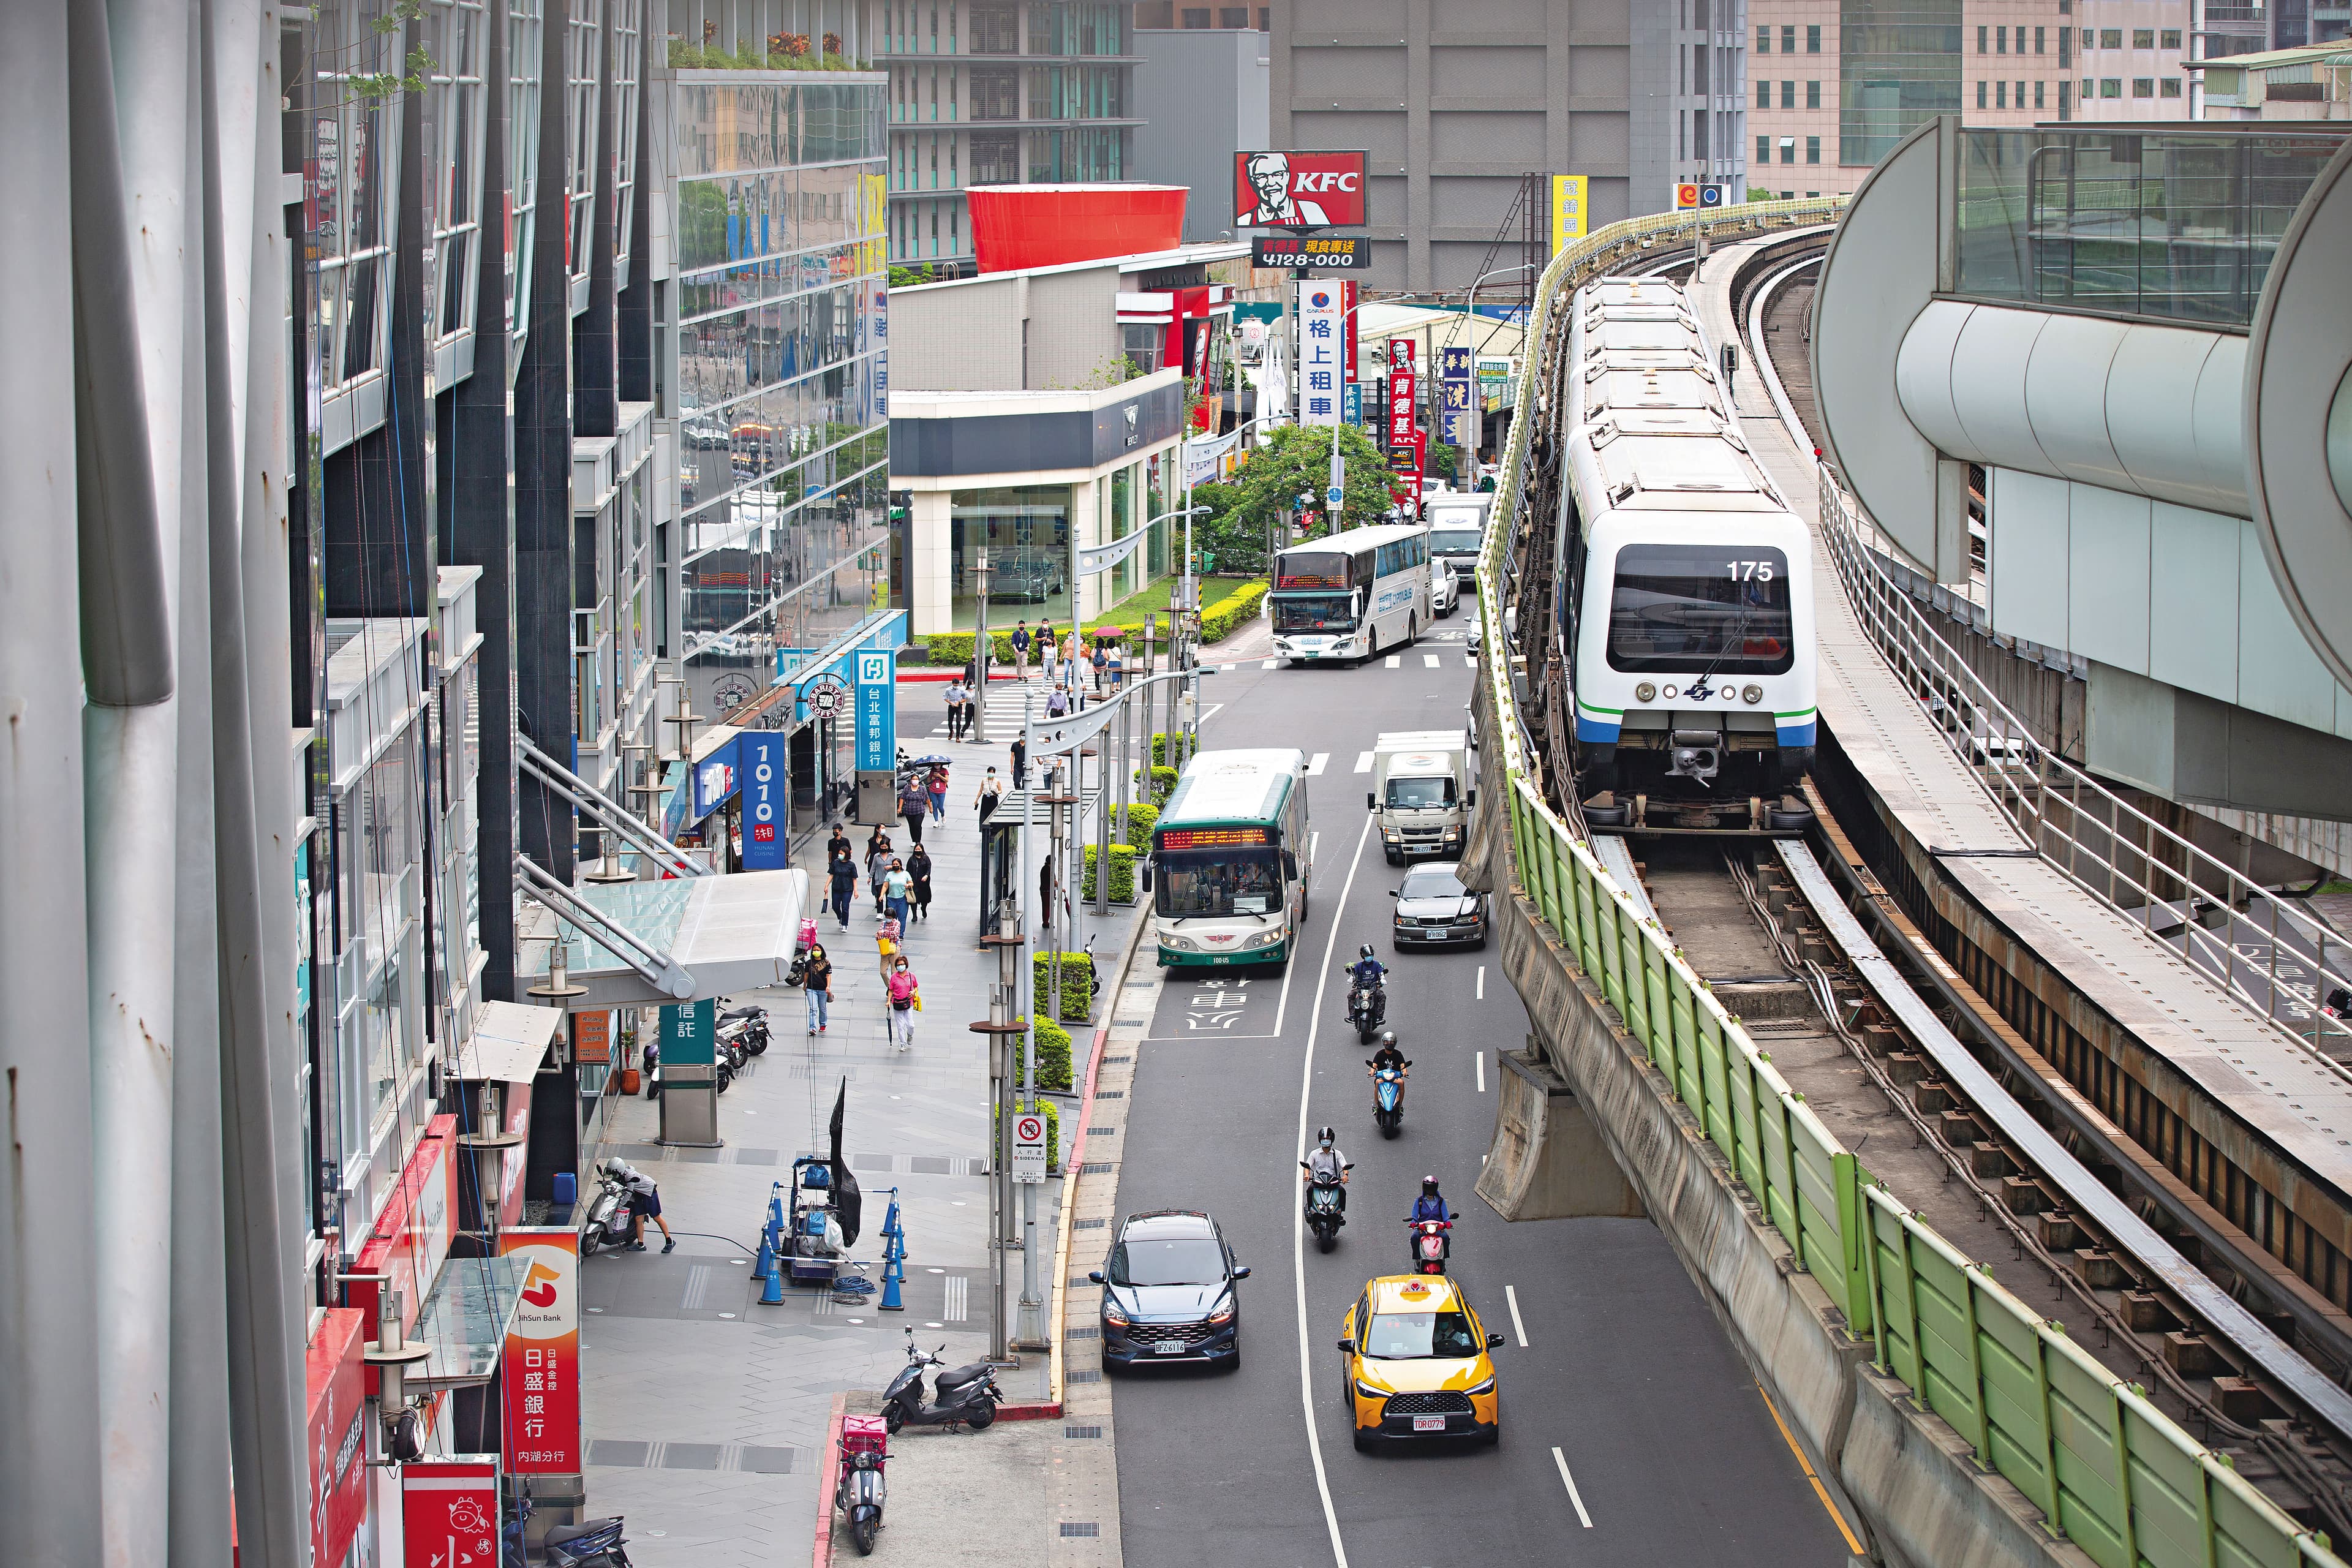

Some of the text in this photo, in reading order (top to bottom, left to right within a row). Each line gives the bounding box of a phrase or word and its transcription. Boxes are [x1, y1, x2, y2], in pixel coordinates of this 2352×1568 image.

[1294, 172, 1359, 192] KFC
[1262, 239, 1355, 254] 肯德基 現食專送
[1262, 254, 1353, 266] 4128-000
[1308, 319, 1332, 416] 格上租車
[1393, 378, 1411, 434] 肯德基
[1727, 560, 1773, 582] 175
[810, 685, 842, 700] BARISTA
[810, 703, 842, 717] COFFEE
[869, 688, 881, 766] 台北富邦銀行
[756, 745, 772, 821] 1010
[677, 1003, 696, 1038] 信託
[518, 1314, 542, 1322] JihSun
[547, 1349, 557, 1391] 日盛金控
[524, 1349, 545, 1438] 日盛銀行
[518, 1451, 565, 1463] 內湖分行
[477, 1539, 489, 1553] 烤
